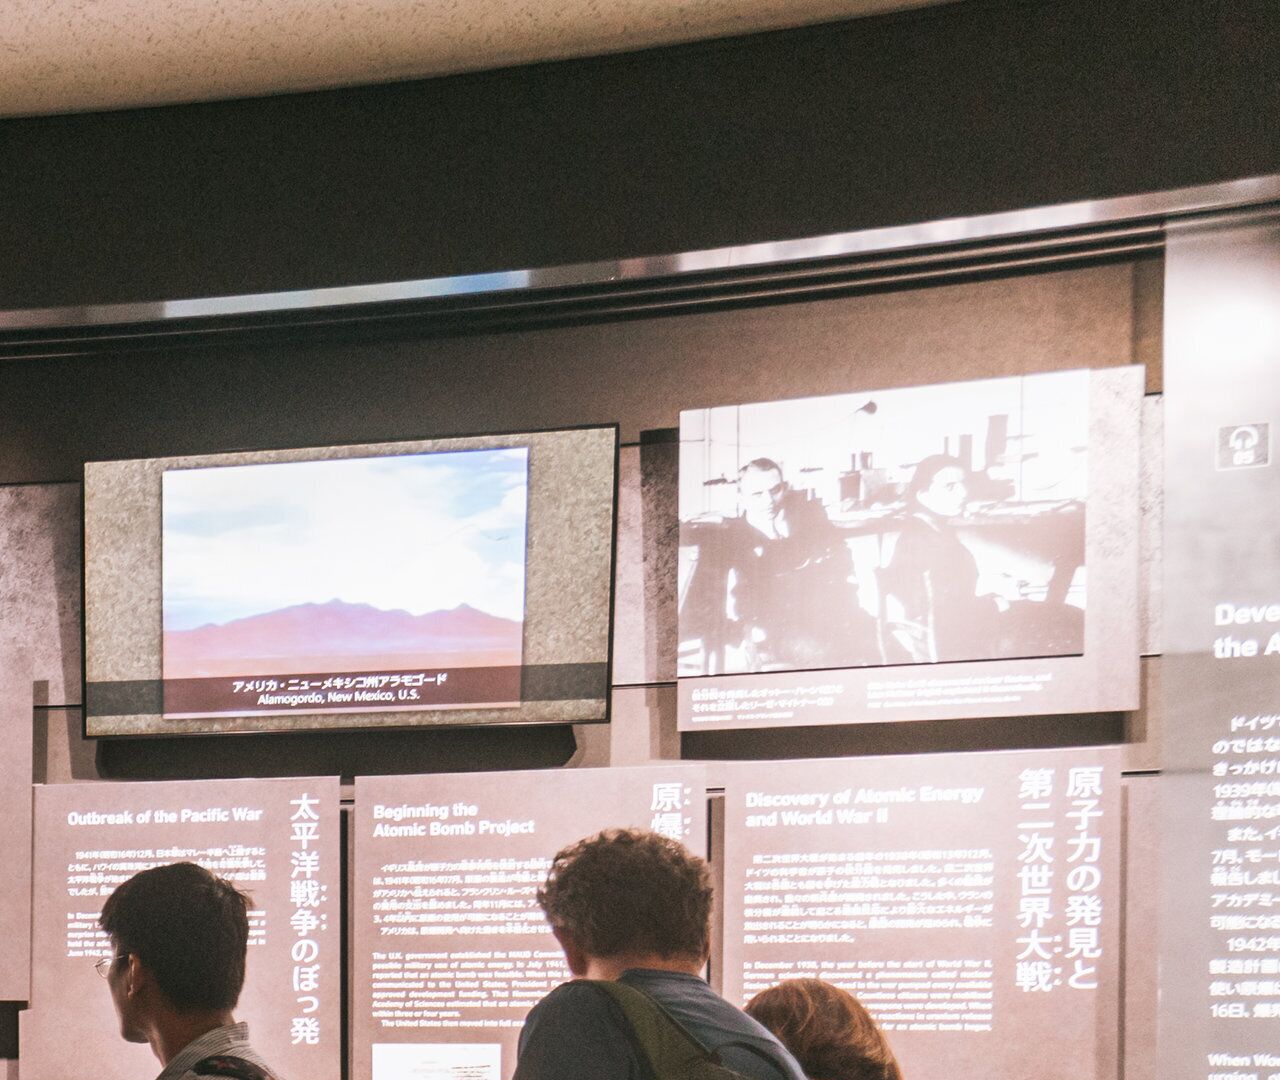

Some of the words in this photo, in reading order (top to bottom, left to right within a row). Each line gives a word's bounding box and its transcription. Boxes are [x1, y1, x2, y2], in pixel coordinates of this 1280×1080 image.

[257, 694, 325, 706] Alamogordo,
[327, 692, 352, 702] New
[354, 691, 395, 702] Mexico,
[398, 690, 420, 700] U.S.
[746, 793, 829, 807] Discovery
[832, 788, 852, 805] of
[854, 788, 916, 804] Atomic
[919, 786, 984, 803] Energy
[67, 811, 133, 825] Outbreak
[136, 810, 151, 824] of
[153, 810, 178, 823] the
[180, 808, 229, 823] Pacific
[232, 807, 262, 821] War
[373, 804, 449, 821] Beginning
[452, 802, 478, 817] the
[650, 783, 683, 840] 原爆
[745, 812, 777, 827] and
[780, 810, 833, 826] World
[836, 809, 873, 824] War
[876, 807, 888, 824] II
[373, 823, 426, 837] Atomic
[429, 821, 475, 836] Bomb
[478, 819, 535, 836] Project
[1016, 768, 1053, 991] 第二次世界大戦
[1065, 767, 1103, 988] 原子力の発見と
[290, 793, 320, 1044] 太平洋戦争のぼっ発
[1253, 1054, 1280, 1067] Wor
